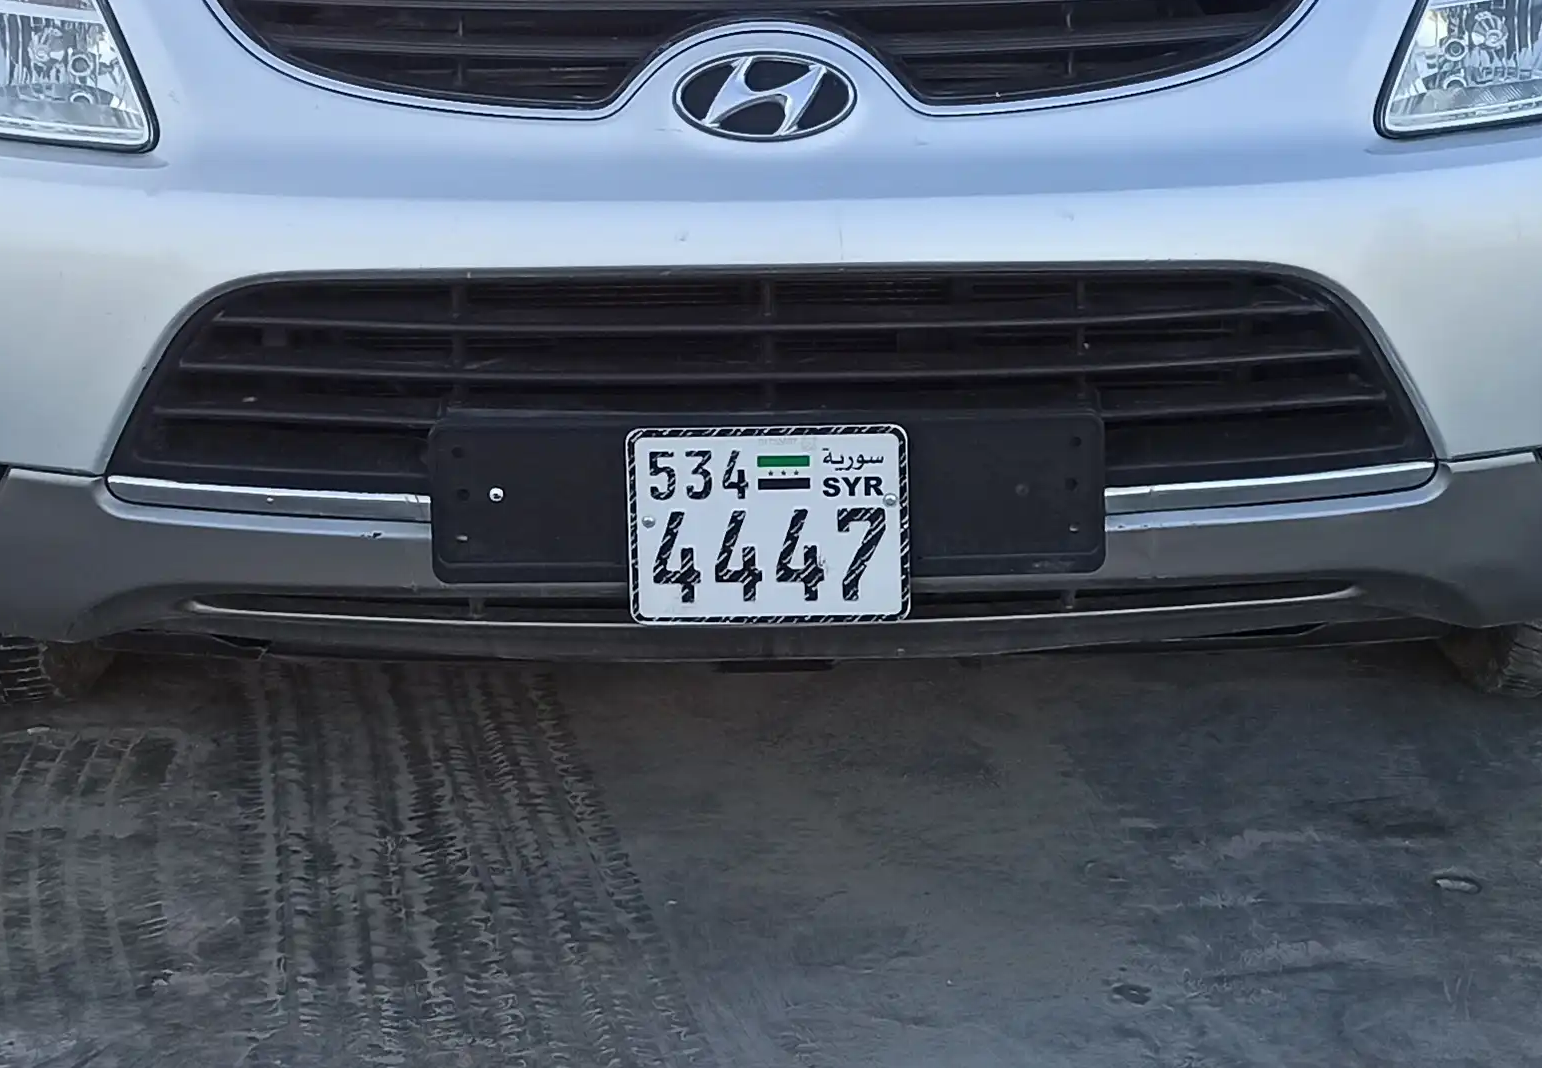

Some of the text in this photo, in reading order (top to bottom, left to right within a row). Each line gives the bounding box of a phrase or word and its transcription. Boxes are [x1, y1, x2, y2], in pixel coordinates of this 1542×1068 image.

[649, 450, 749, 500] 534
[822, 448, 884, 471] سورية
[822, 476, 884, 497] SYR
[653, 507, 887, 603] 4447
